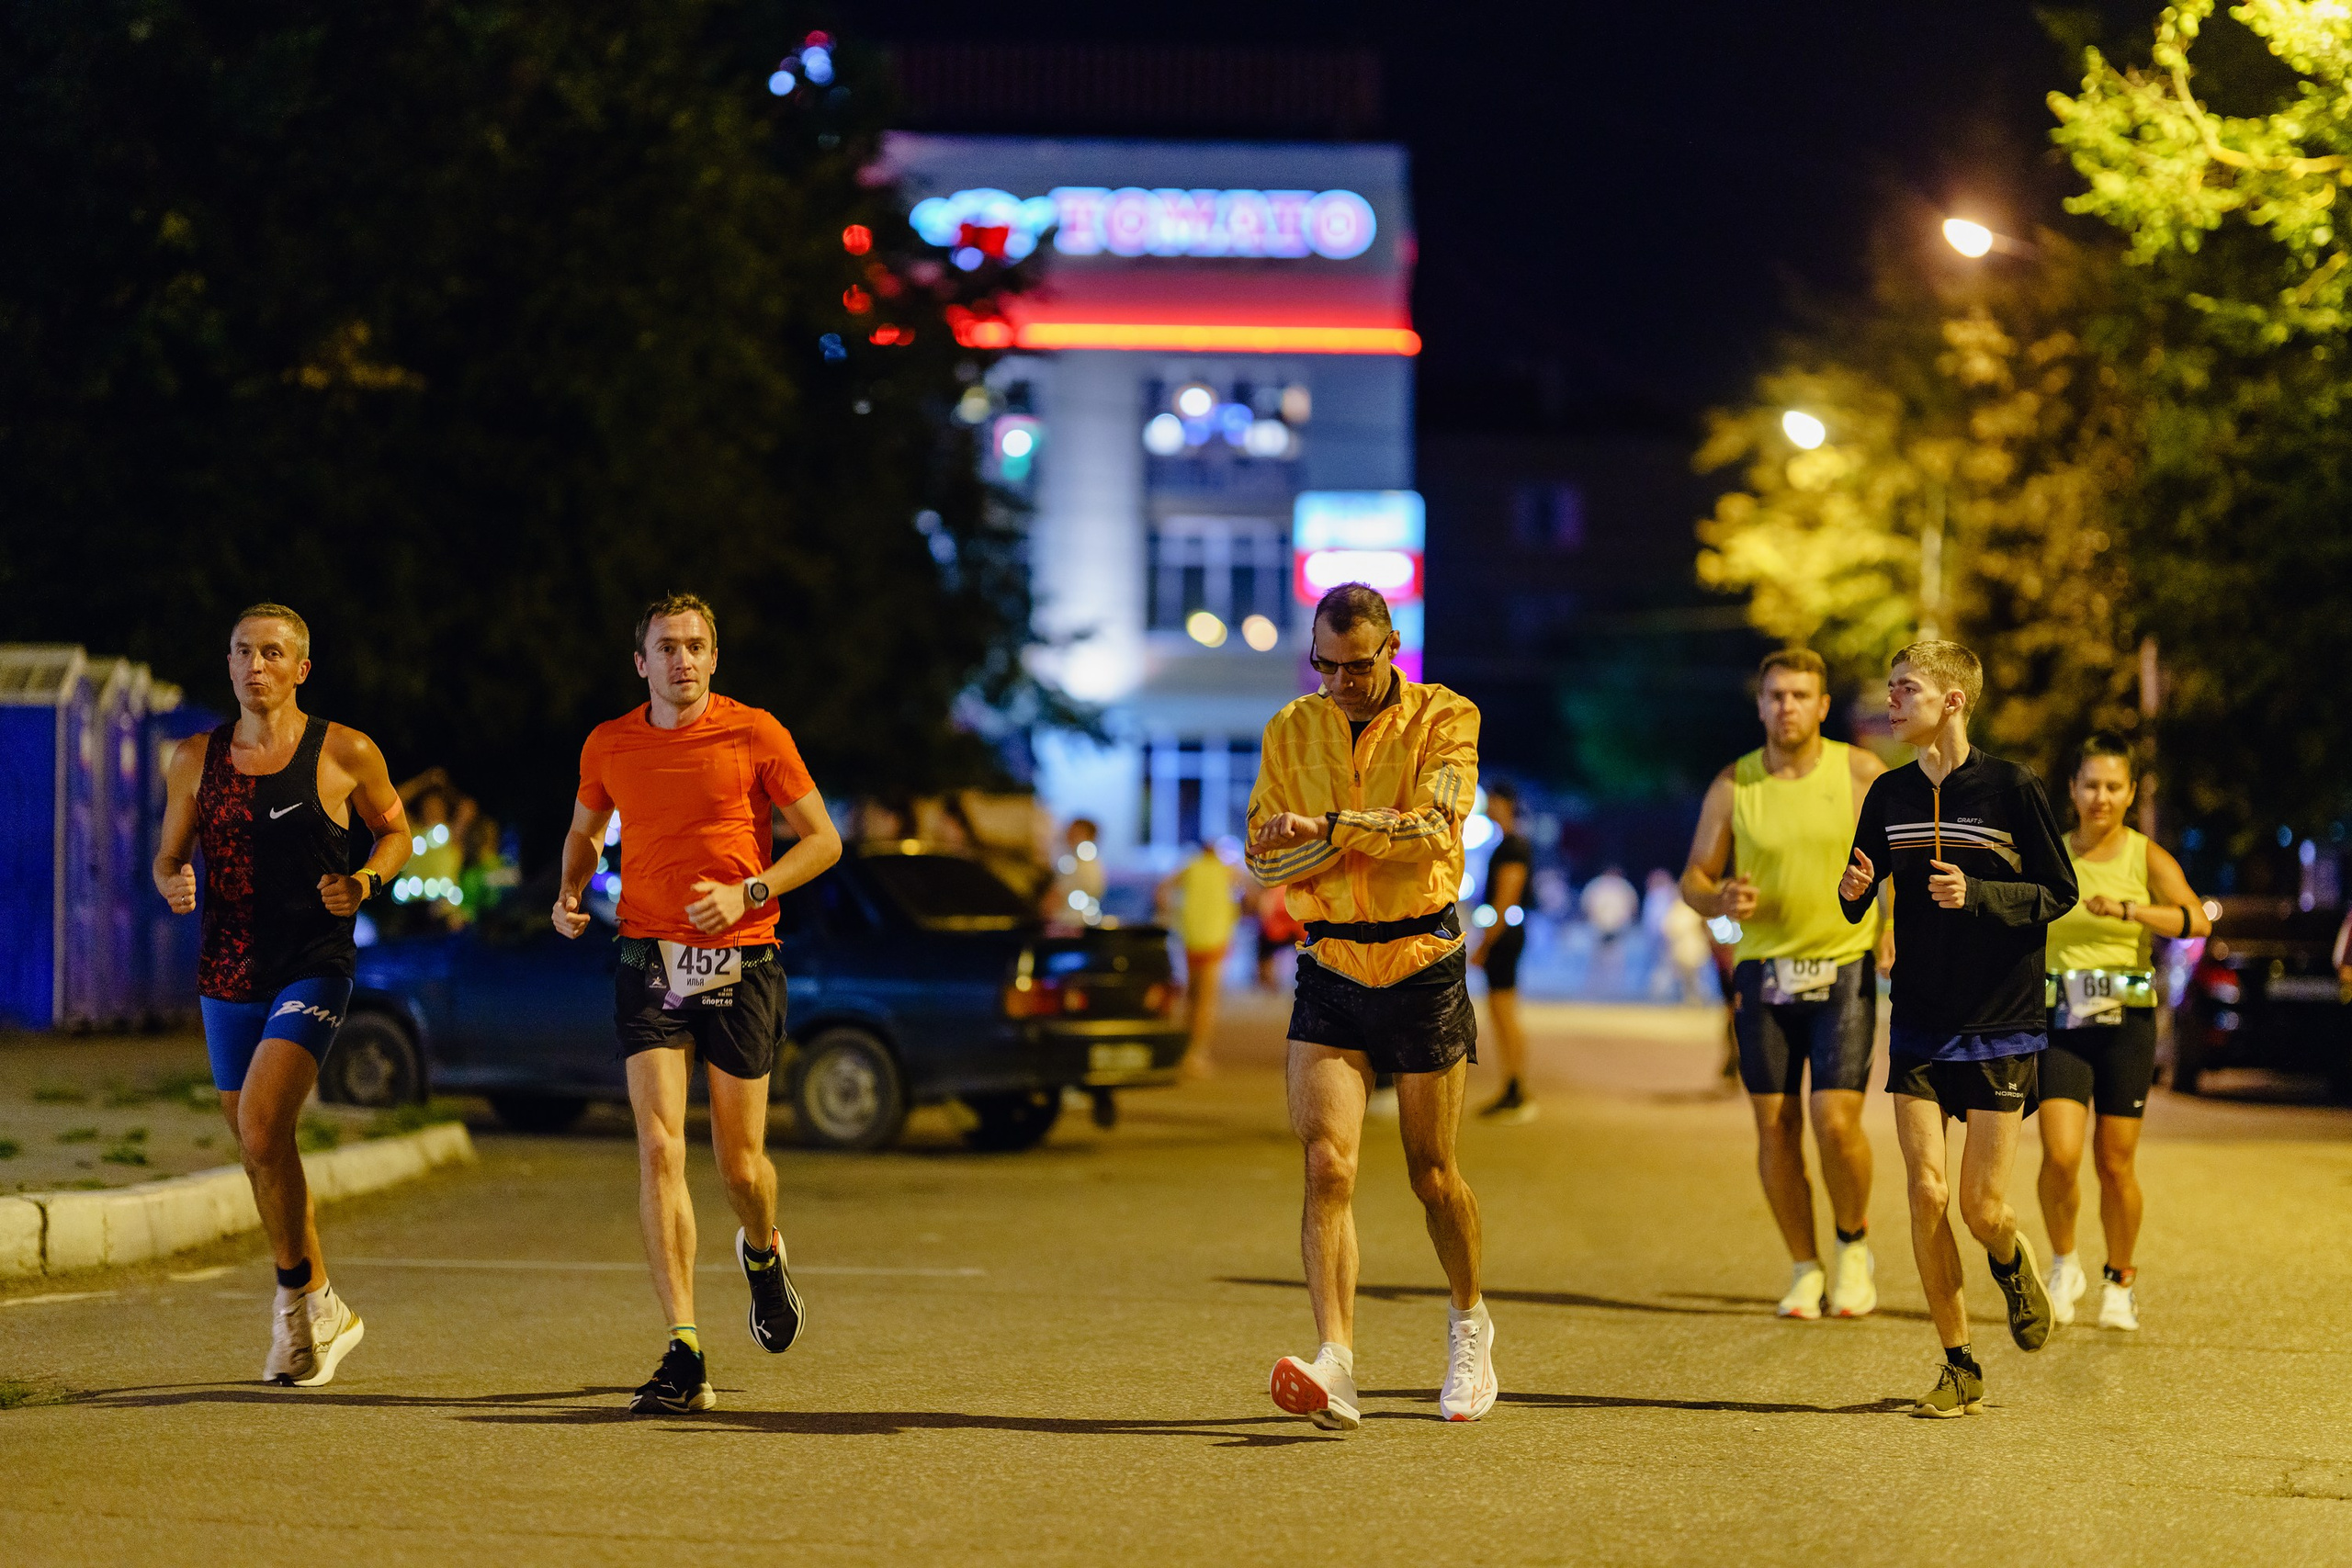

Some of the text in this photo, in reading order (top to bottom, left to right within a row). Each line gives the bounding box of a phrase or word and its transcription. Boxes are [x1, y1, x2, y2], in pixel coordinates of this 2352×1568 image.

[677, 945, 731, 976] 452
[686, 977, 705, 987] ИЛЬЯ
[2084, 976, 2110, 997] 69
